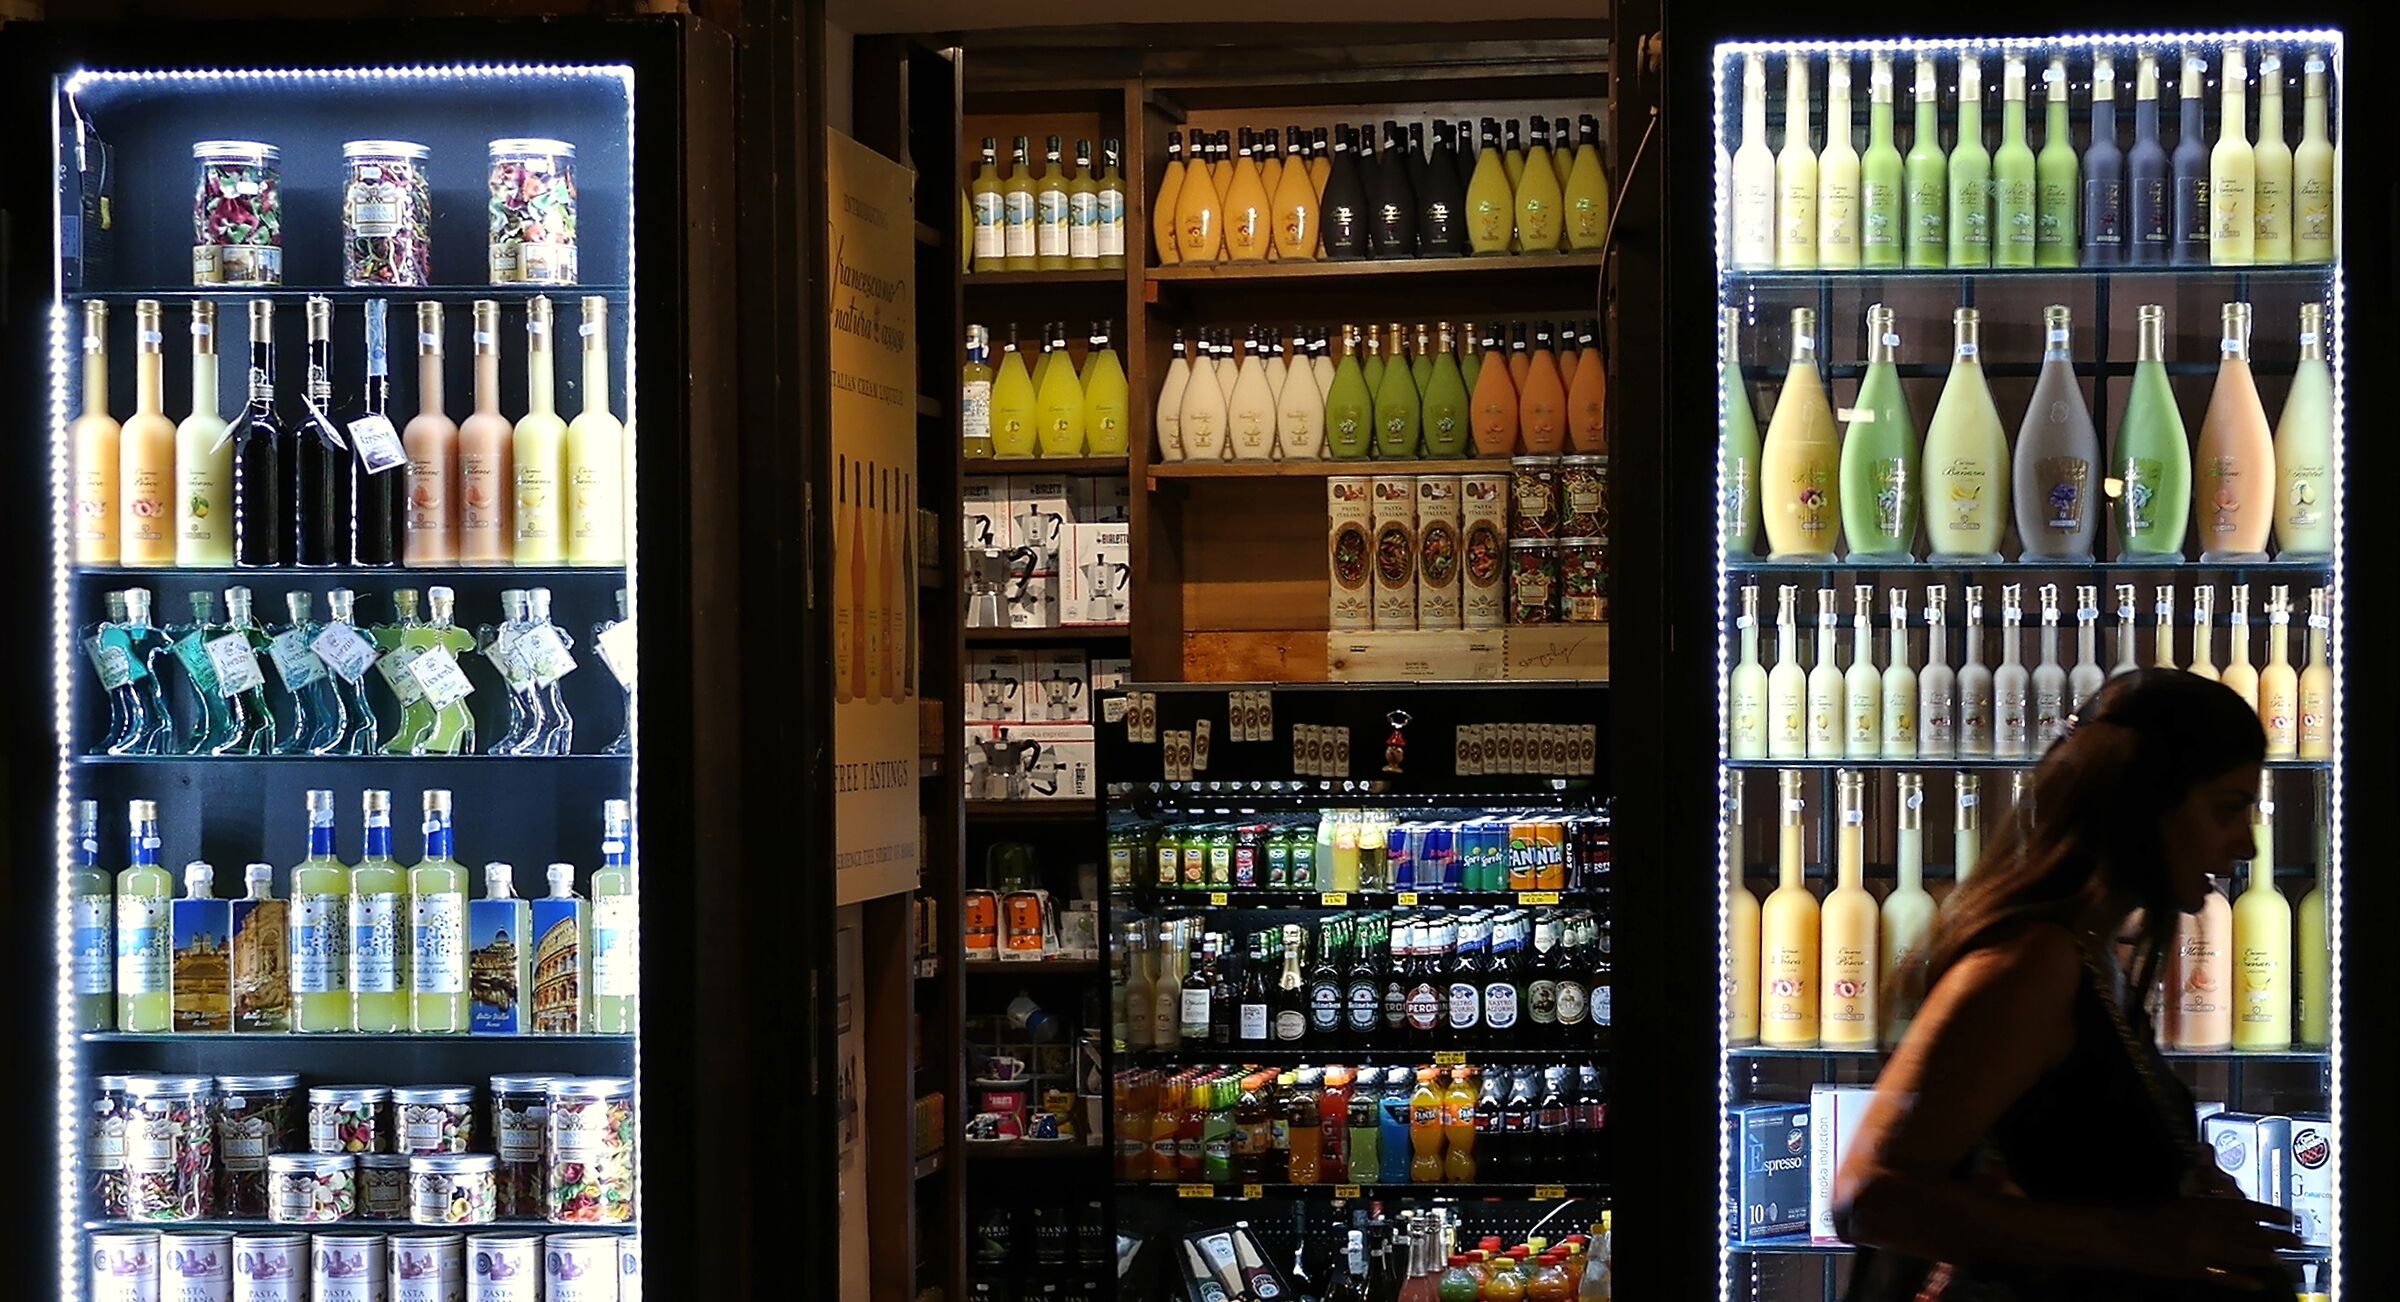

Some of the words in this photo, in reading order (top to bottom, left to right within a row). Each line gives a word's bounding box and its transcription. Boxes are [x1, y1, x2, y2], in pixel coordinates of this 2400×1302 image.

[834, 296, 871, 339] natura
[862, 760, 909, 790] TASTINGS
[1820, 1171, 1830, 1198] moka
[1749, 1204, 1764, 1225] 10
[249, 1289, 278, 1297] PASTA
[323, 1289, 352, 1297] PASTA
